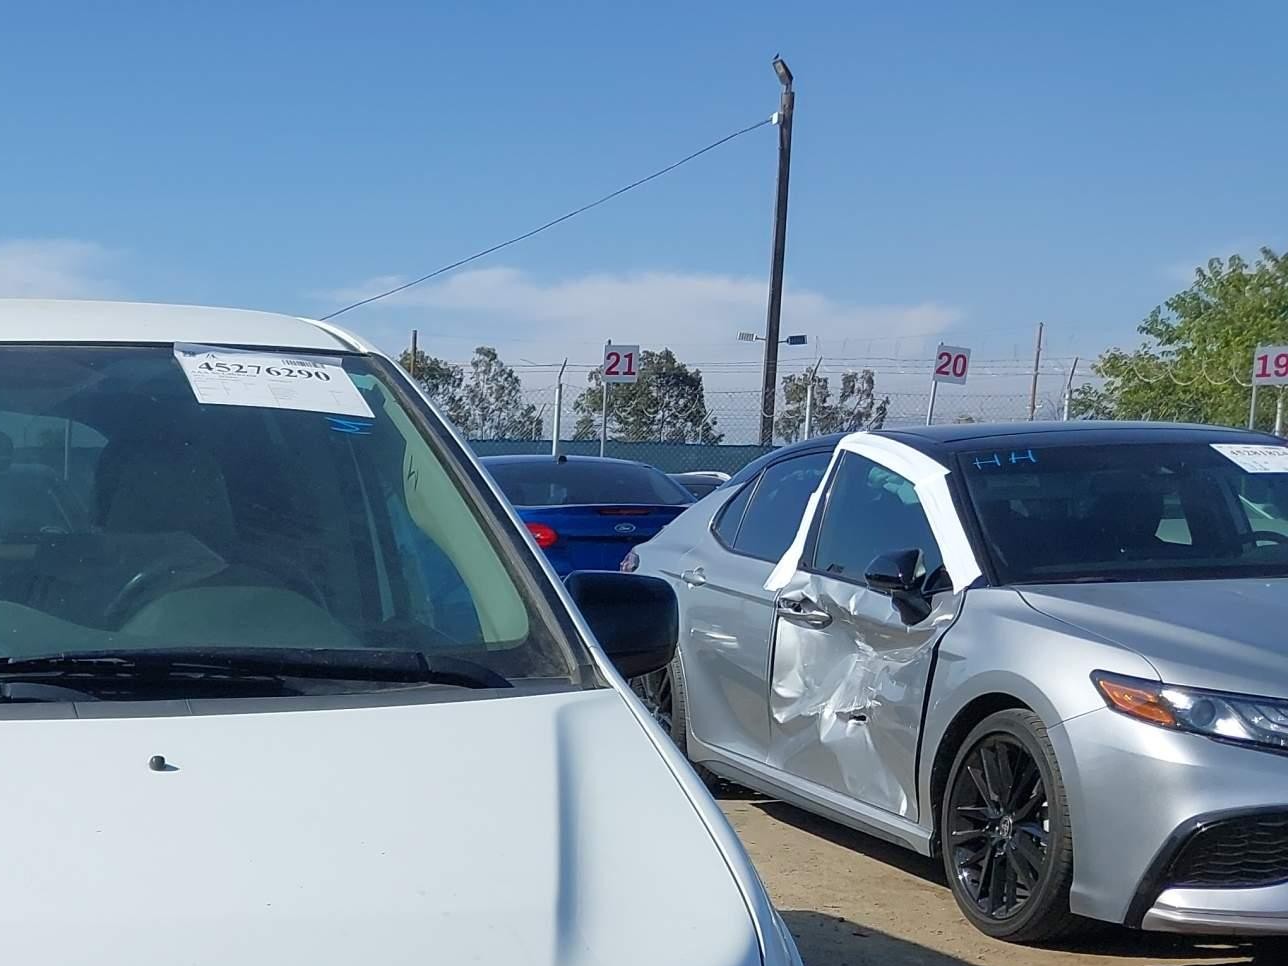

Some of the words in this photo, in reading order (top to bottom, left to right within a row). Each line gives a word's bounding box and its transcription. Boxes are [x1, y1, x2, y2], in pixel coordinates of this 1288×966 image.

[198, 361, 331, 382] 45276290
[605, 352, 636, 376] 21
[935, 352, 967, 378] 20
[1255, 353, 1288, 377] 19
